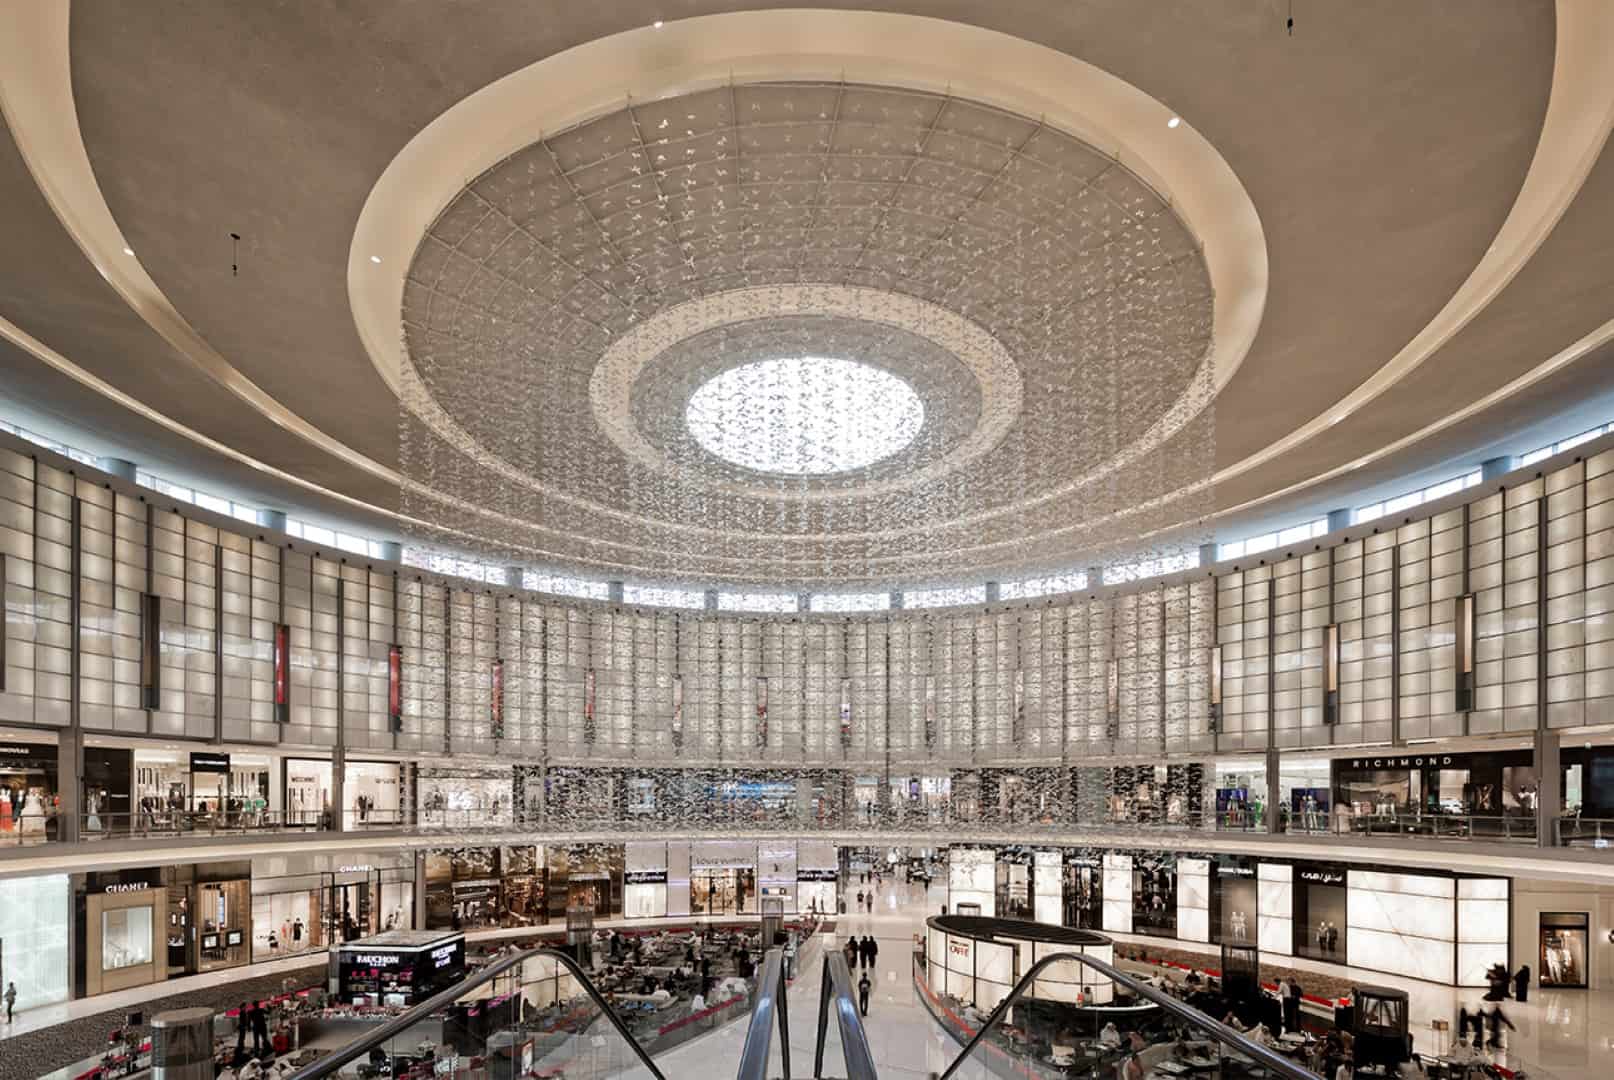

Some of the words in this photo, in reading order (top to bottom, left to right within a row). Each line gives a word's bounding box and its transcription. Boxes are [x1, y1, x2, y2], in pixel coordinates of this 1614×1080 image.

[1352, 756, 1452, 768] RICHMOND
[339, 864, 375, 873] CHANEL
[105, 881, 148, 895] CHANEL
